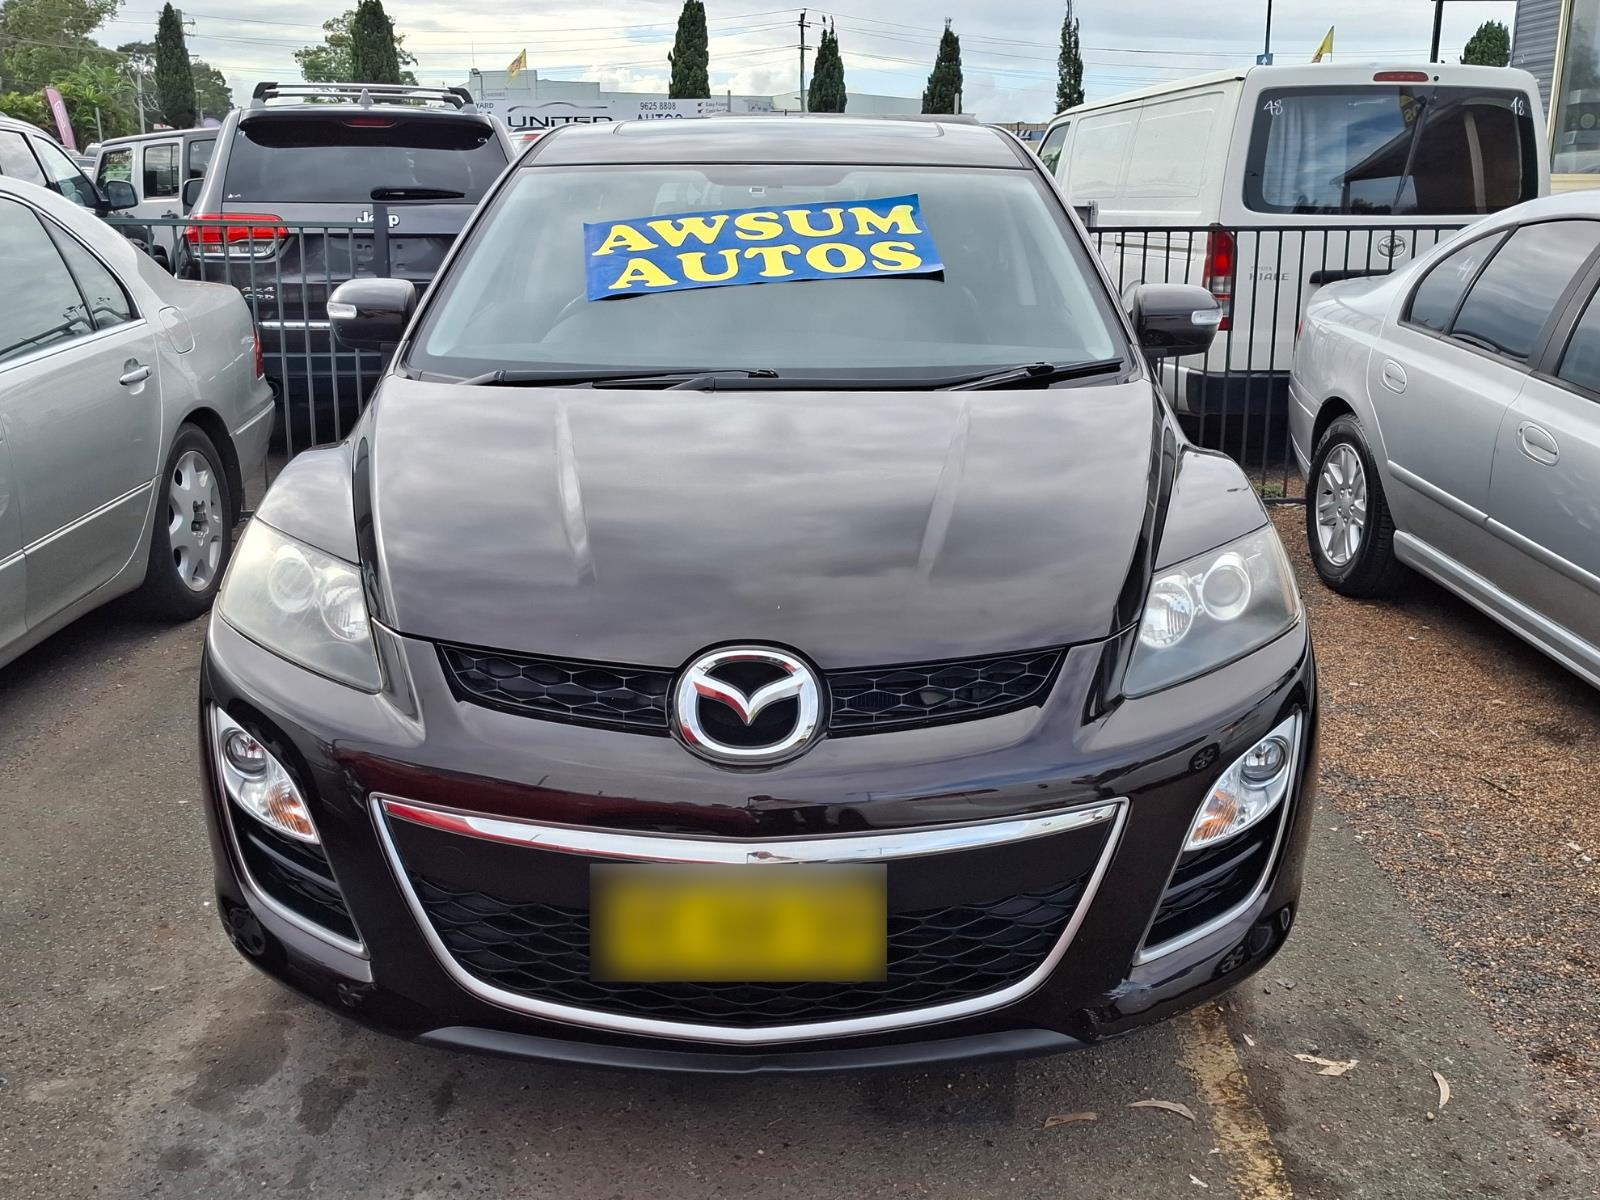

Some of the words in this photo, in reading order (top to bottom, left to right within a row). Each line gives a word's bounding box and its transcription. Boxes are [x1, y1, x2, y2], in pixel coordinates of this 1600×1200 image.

[639, 101, 658, 111] 9625
[659, 101, 677, 111] 8808
[1263, 99, 1284, 116] 48
[592, 204, 923, 256] AWSUM
[608, 241, 922, 289] AUTOS
